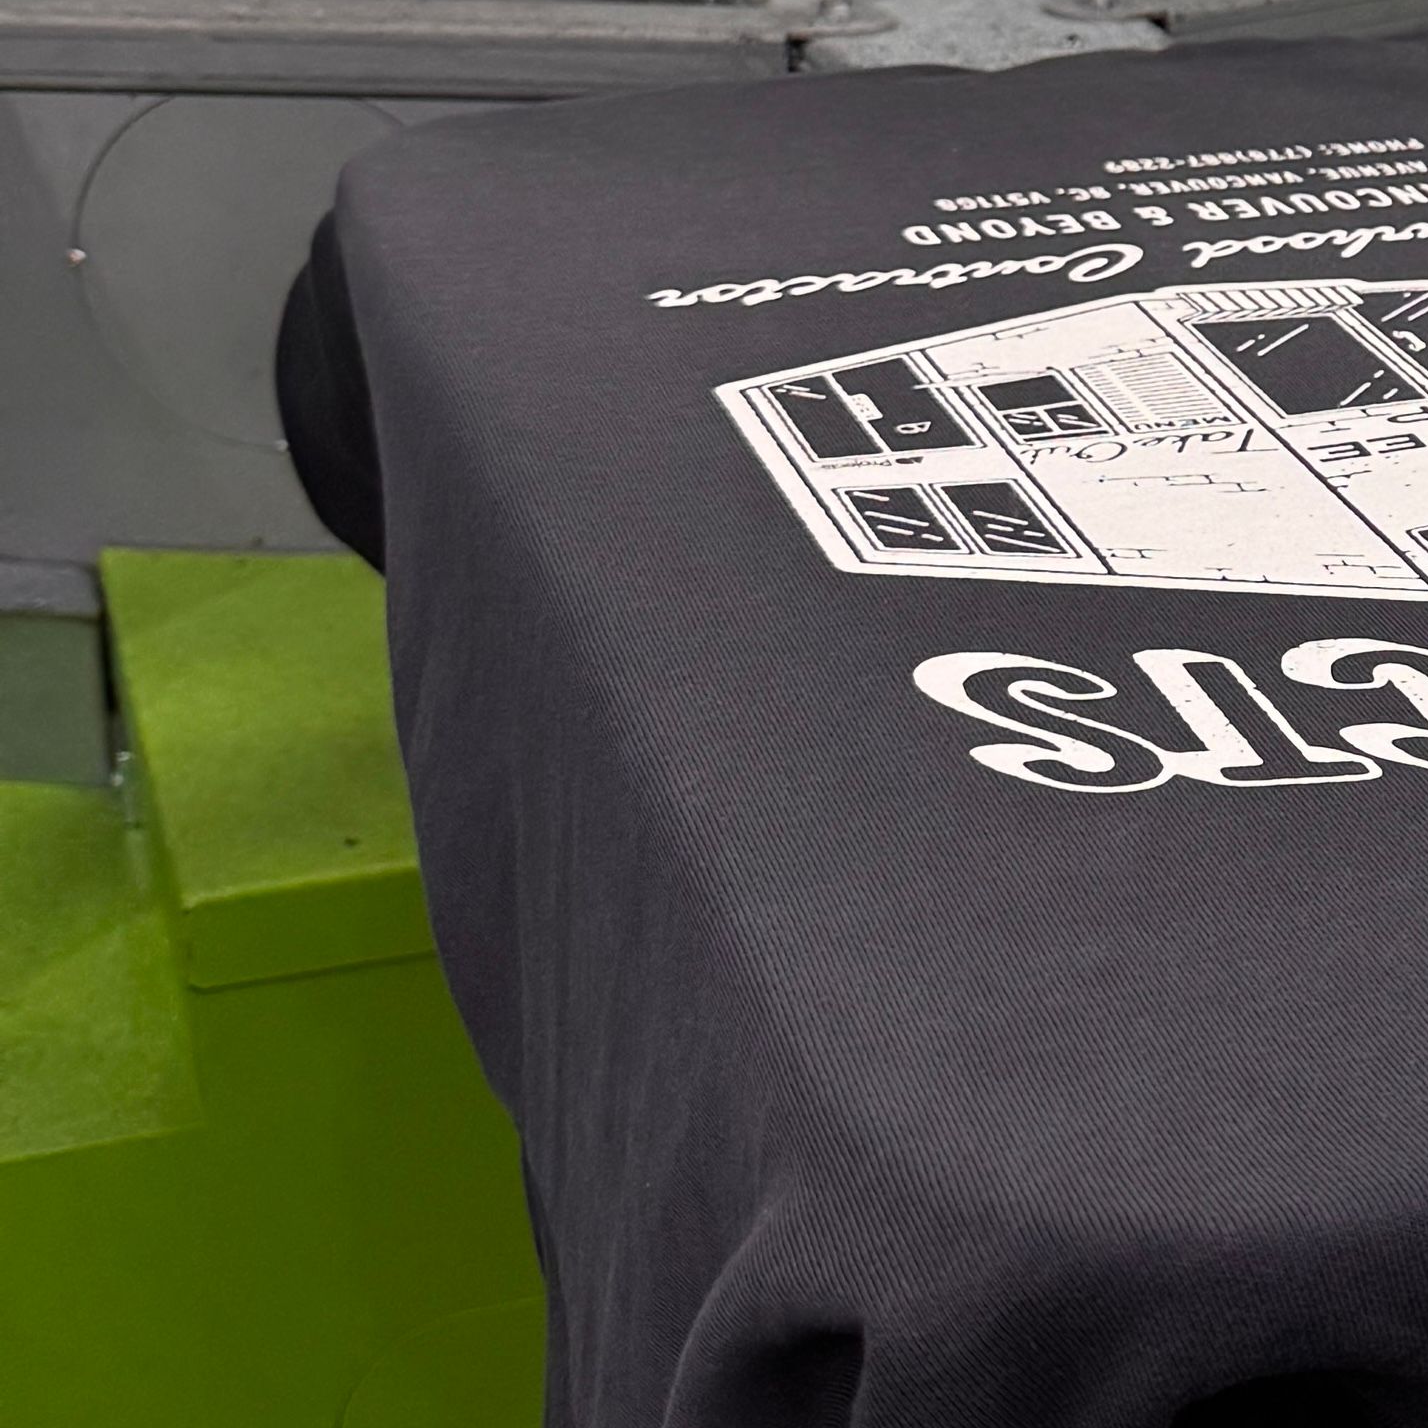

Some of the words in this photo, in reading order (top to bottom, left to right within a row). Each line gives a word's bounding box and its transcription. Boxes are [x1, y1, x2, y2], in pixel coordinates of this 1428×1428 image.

[1318, 137, 1425, 157] PHONE:
[1133, 206, 1174, 226] &
[902, 210, 1121, 247] BEYOND
[645, 242, 1144, 308] Contractor
[1131, 415, 1232, 433] MENU
[1018, 441, 1127, 465] Out
[1133, 428, 1279, 455] Take
